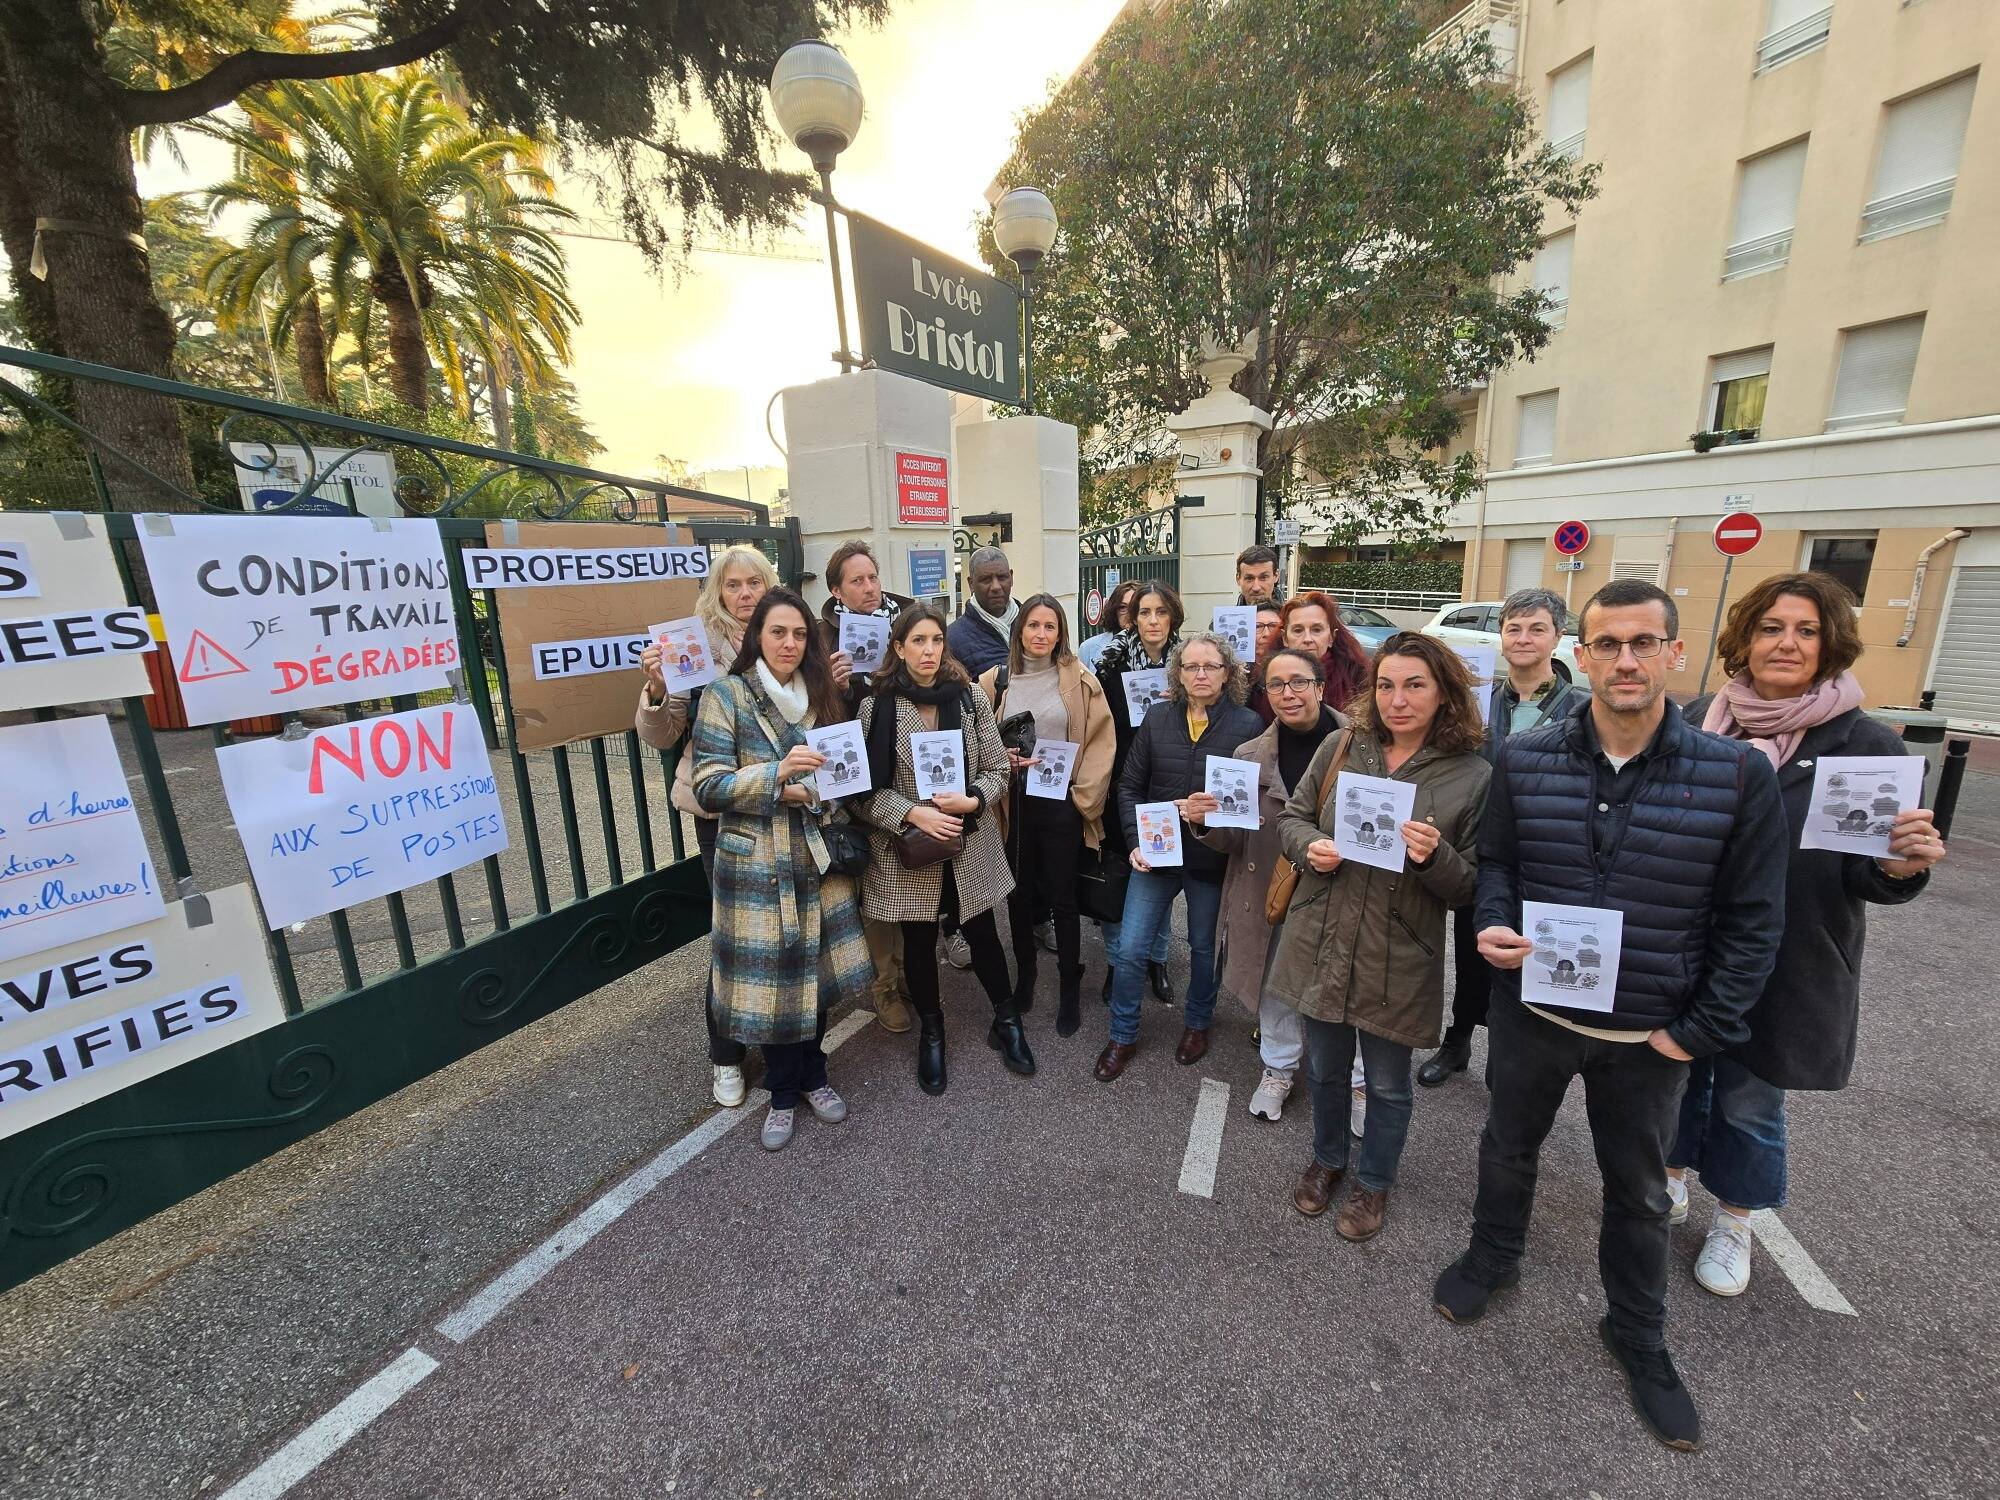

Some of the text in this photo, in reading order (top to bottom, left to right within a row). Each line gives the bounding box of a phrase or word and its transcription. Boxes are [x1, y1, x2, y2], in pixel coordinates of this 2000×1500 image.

[912, 257, 982, 316] Lycée
[887, 301, 1005, 384] Bristol
[900, 474, 946, 487] A TOUTE PERSONNE
[920, 461, 941, 472] INTERDIT
[901, 506, 905, 515] A
[471, 551, 707, 583] PROFESSEURS
[0, 612, 150, 664] EES
[243, 616, 285, 650] DE
[270, 637, 457, 695] DÉGRADÉES
[540, 639, 655, 675] EPUIS
[308, 711, 454, 794] NON
[270, 823, 319, 858] AUX
[329, 814, 500, 887] DE POSTES
[0, 945, 153, 1022] VES
